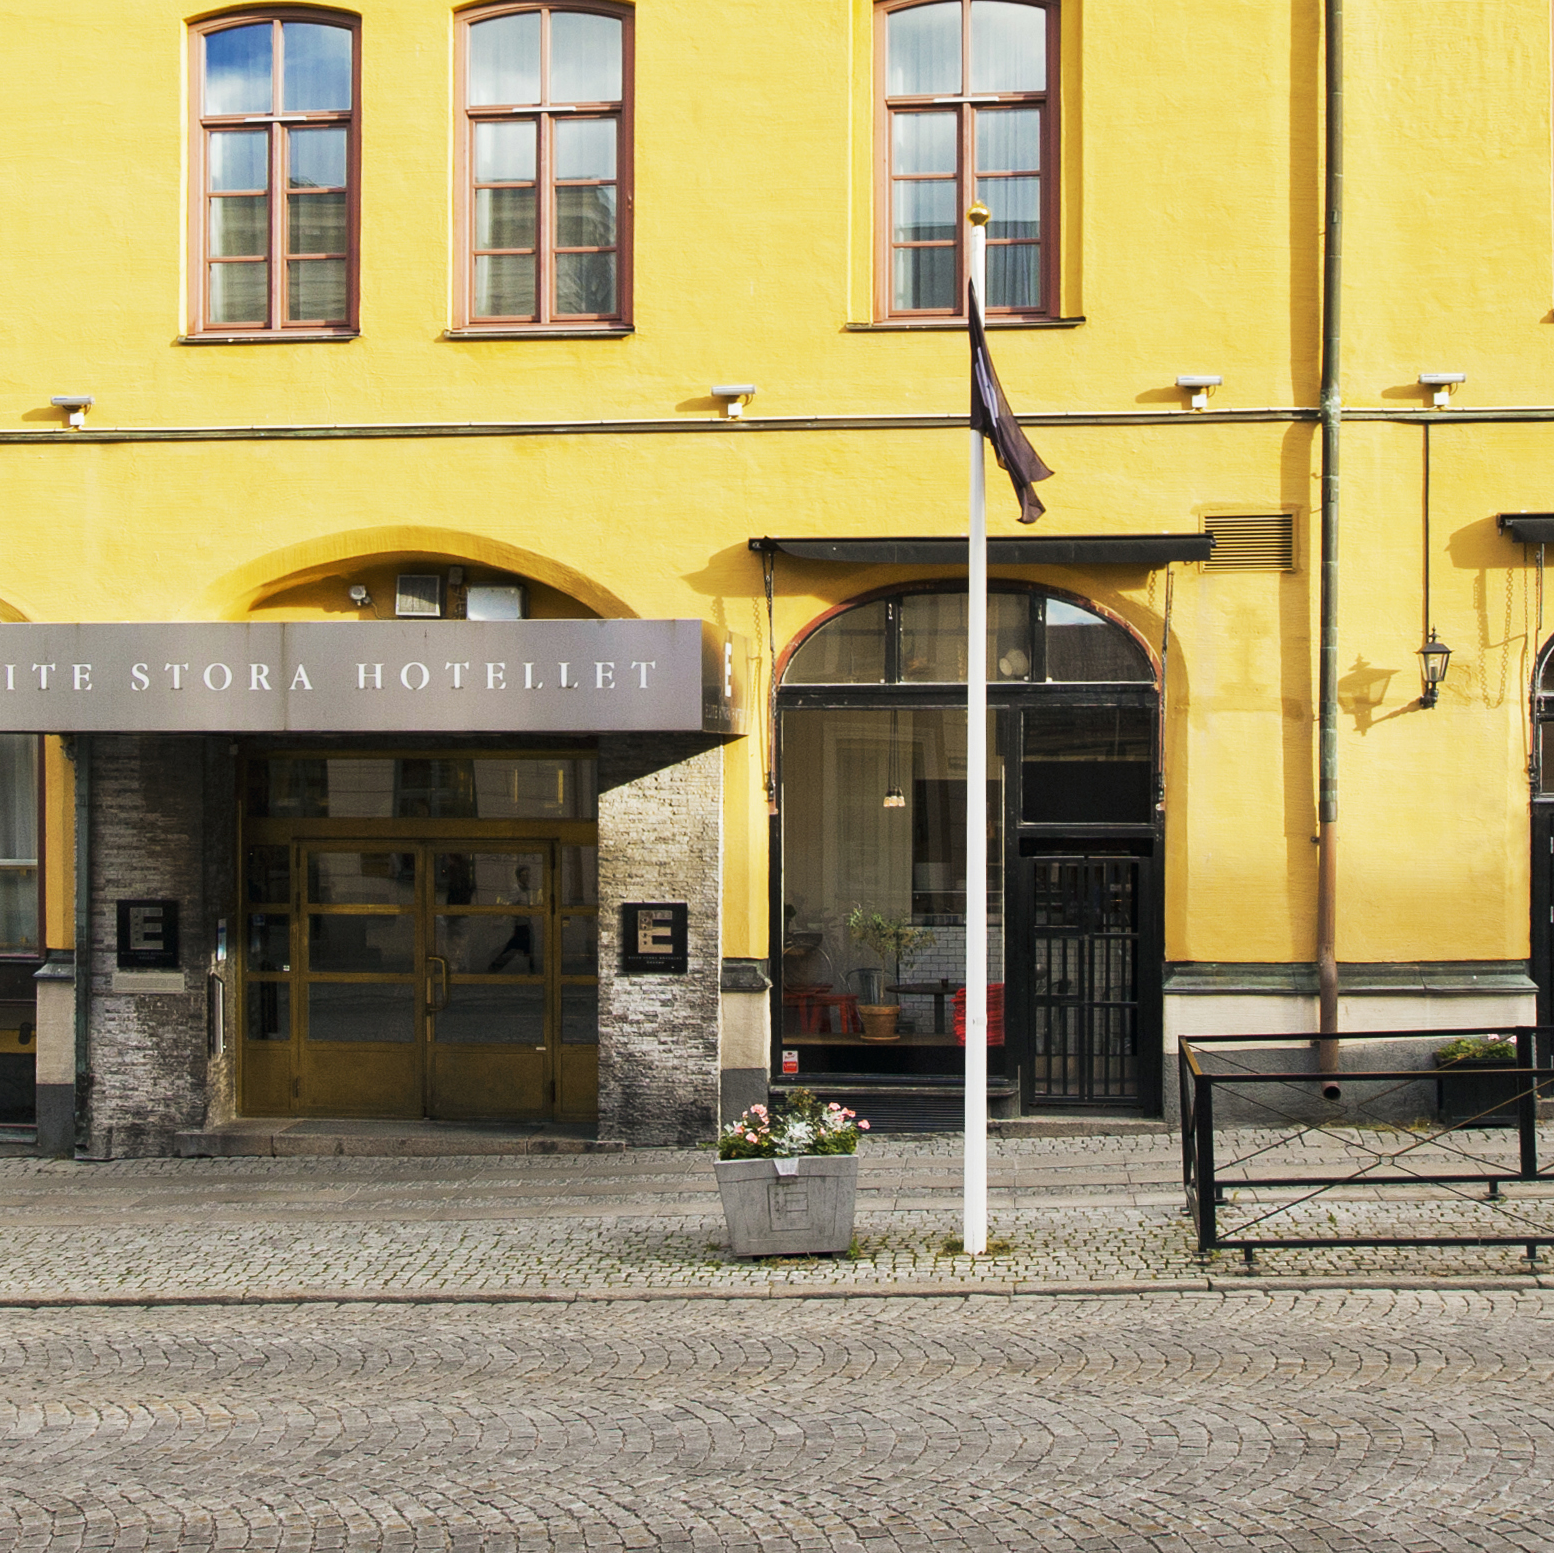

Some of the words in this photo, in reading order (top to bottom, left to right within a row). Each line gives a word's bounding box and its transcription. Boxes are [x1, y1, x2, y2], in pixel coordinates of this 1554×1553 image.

[130, 662, 313, 691] STORA
[355, 661, 656, 690] HOTELLET
[130, 907, 163, 950] E
[637, 910, 673, 954] E
